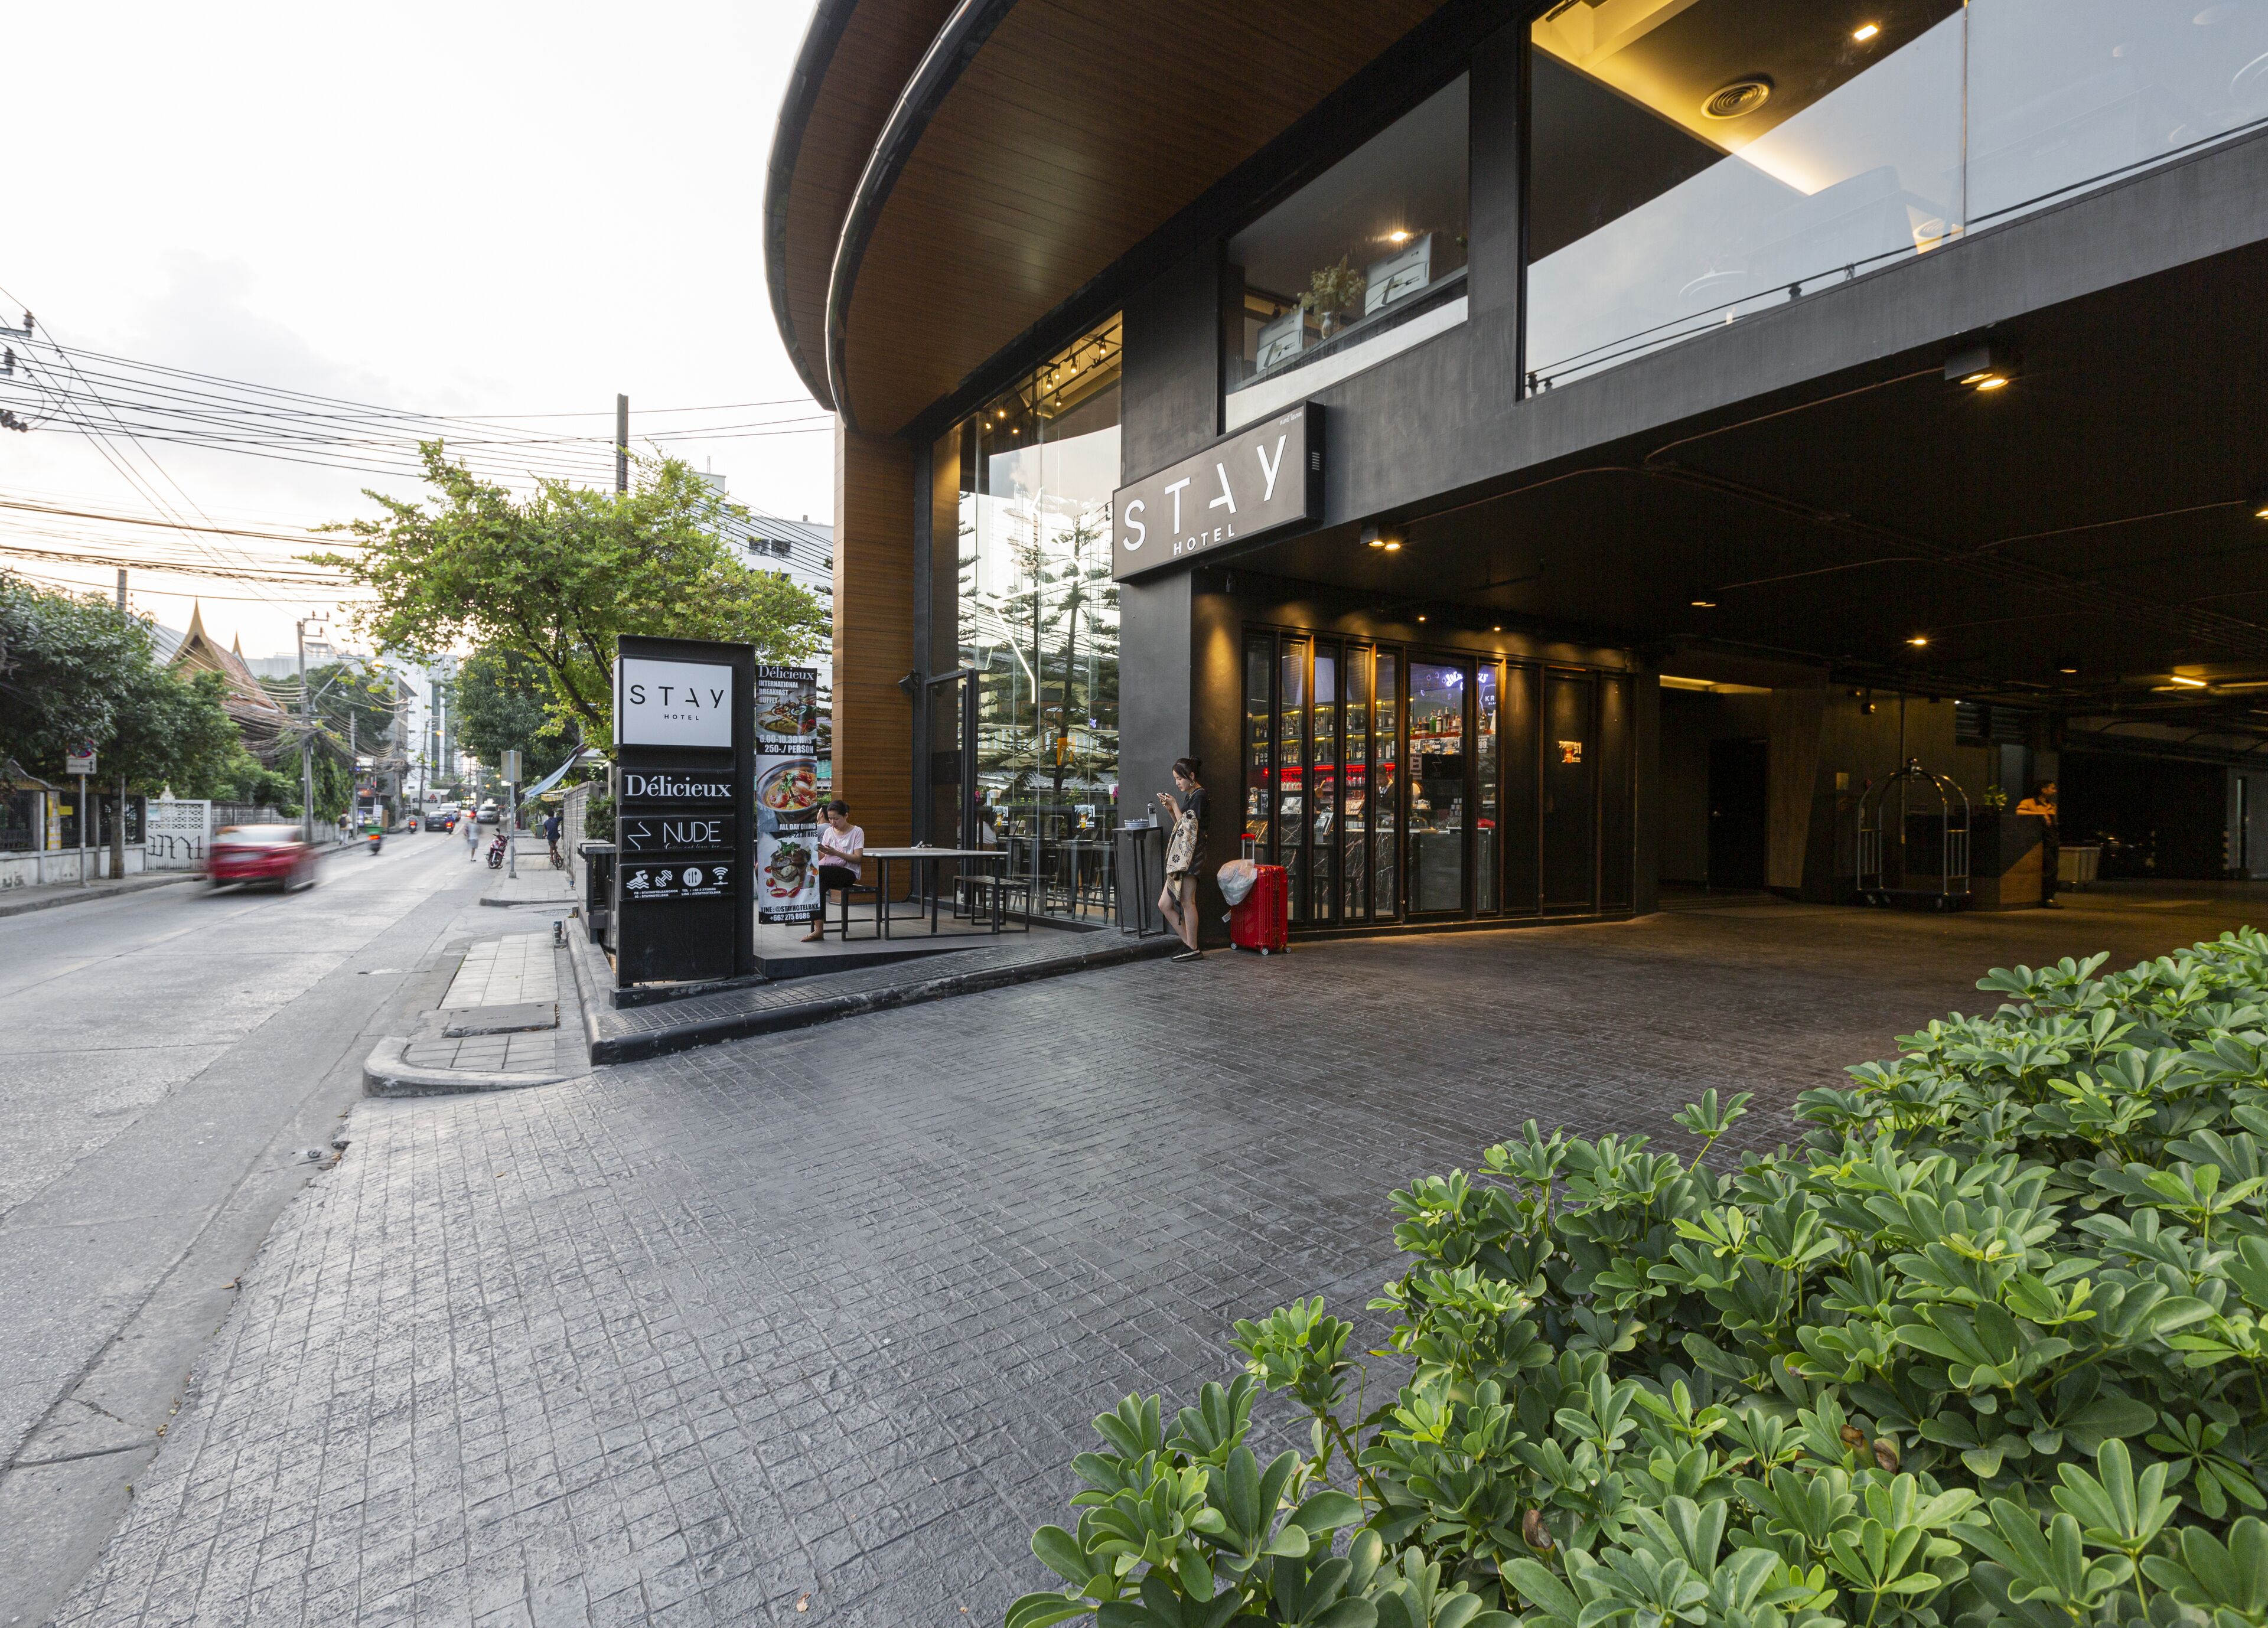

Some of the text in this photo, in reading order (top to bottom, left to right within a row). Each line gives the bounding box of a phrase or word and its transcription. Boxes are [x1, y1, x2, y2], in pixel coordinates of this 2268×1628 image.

[1123, 434, 1288, 552] STAY
[1174, 524, 1236, 556] HOTEL
[758, 665, 814, 680] Délicieux
[758, 680, 799, 688] INTERNATIONAL
[630, 684, 724, 709] STAY
[760, 735, 812, 744] 6.00-10.30 HRS
[788, 745, 814, 753] PERSON
[625, 775, 732, 797] Délicieux
[664, 821, 721, 843] NUDE
[775, 903, 819, 913] @STAYHOTELBKK
